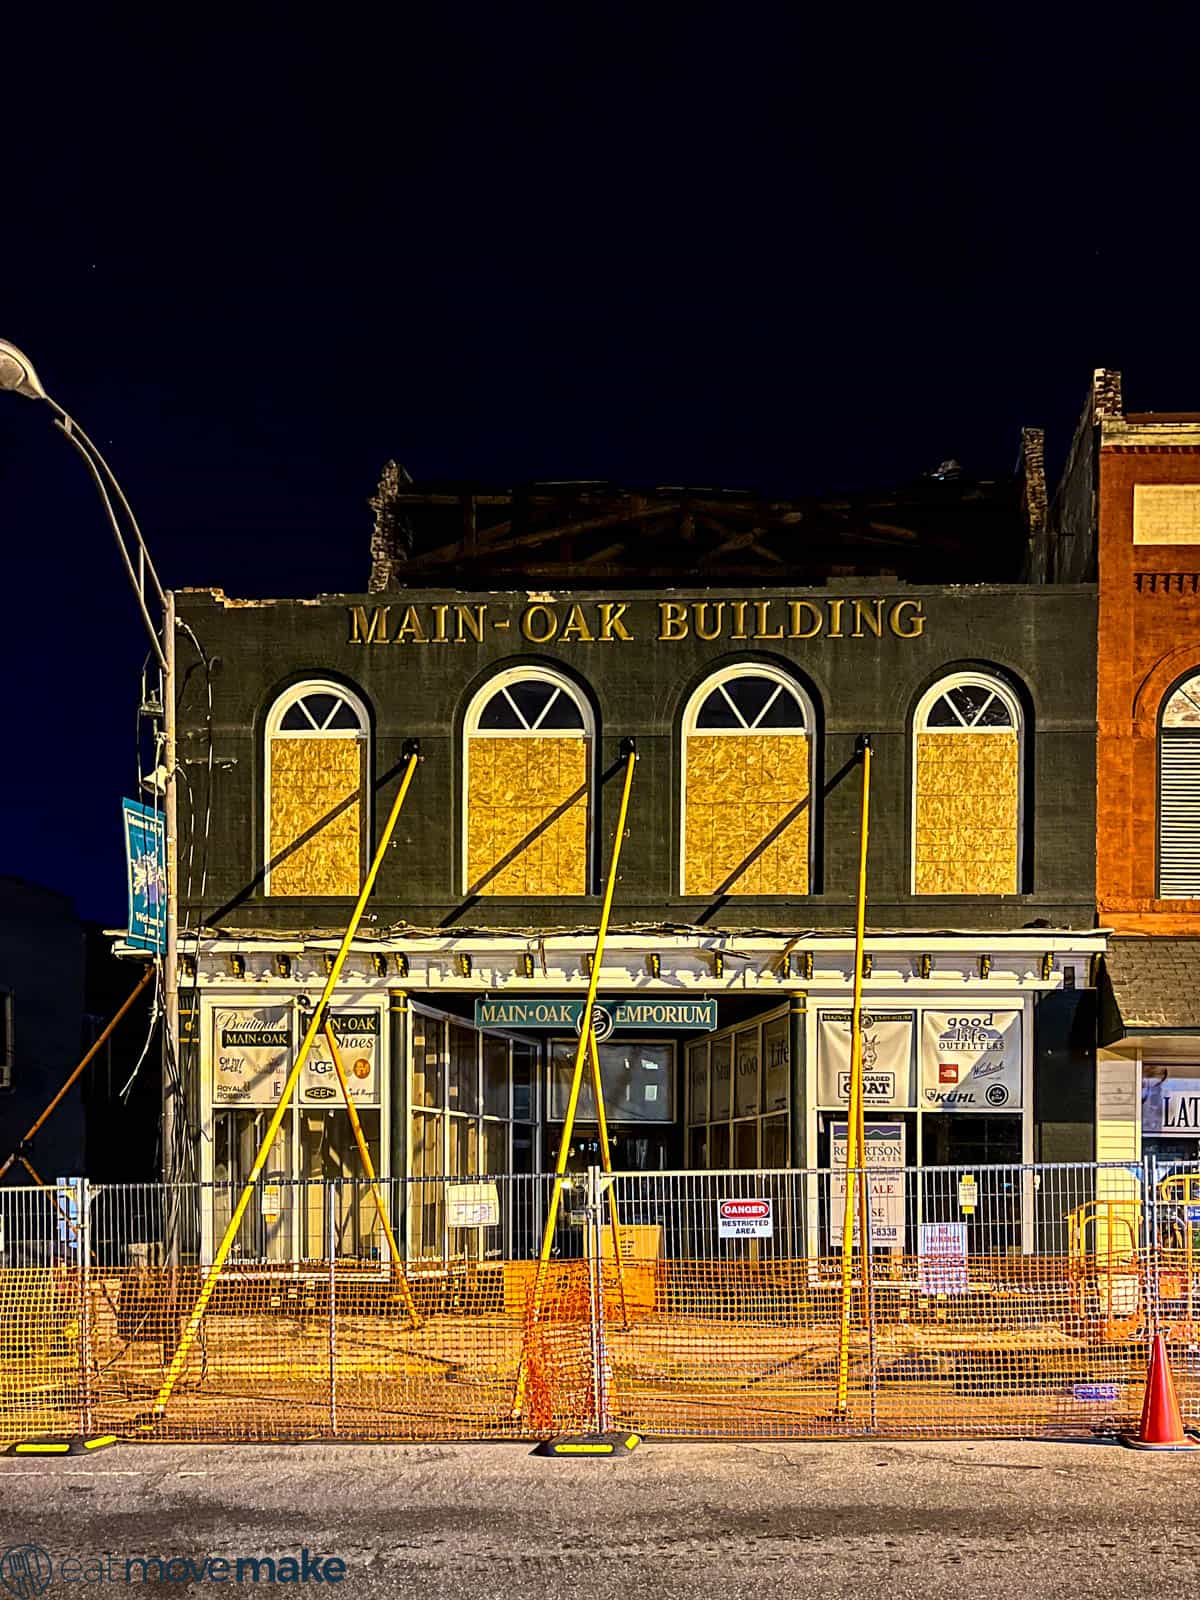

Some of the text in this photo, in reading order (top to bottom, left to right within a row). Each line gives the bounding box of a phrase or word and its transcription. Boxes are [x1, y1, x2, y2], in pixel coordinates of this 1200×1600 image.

[658, 599, 927, 641] BUILDING
[615, 1006, 712, 1024] EMPORIUM
[947, 1013, 994, 1029] good
[956, 1027, 988, 1045] life
[938, 1042, 1005, 1050] OUTFITTERS
[309, 1060, 333, 1074] UGG
[935, 1089, 976, 1103] KÜHL
[724, 1206, 766, 1214] DANGER
